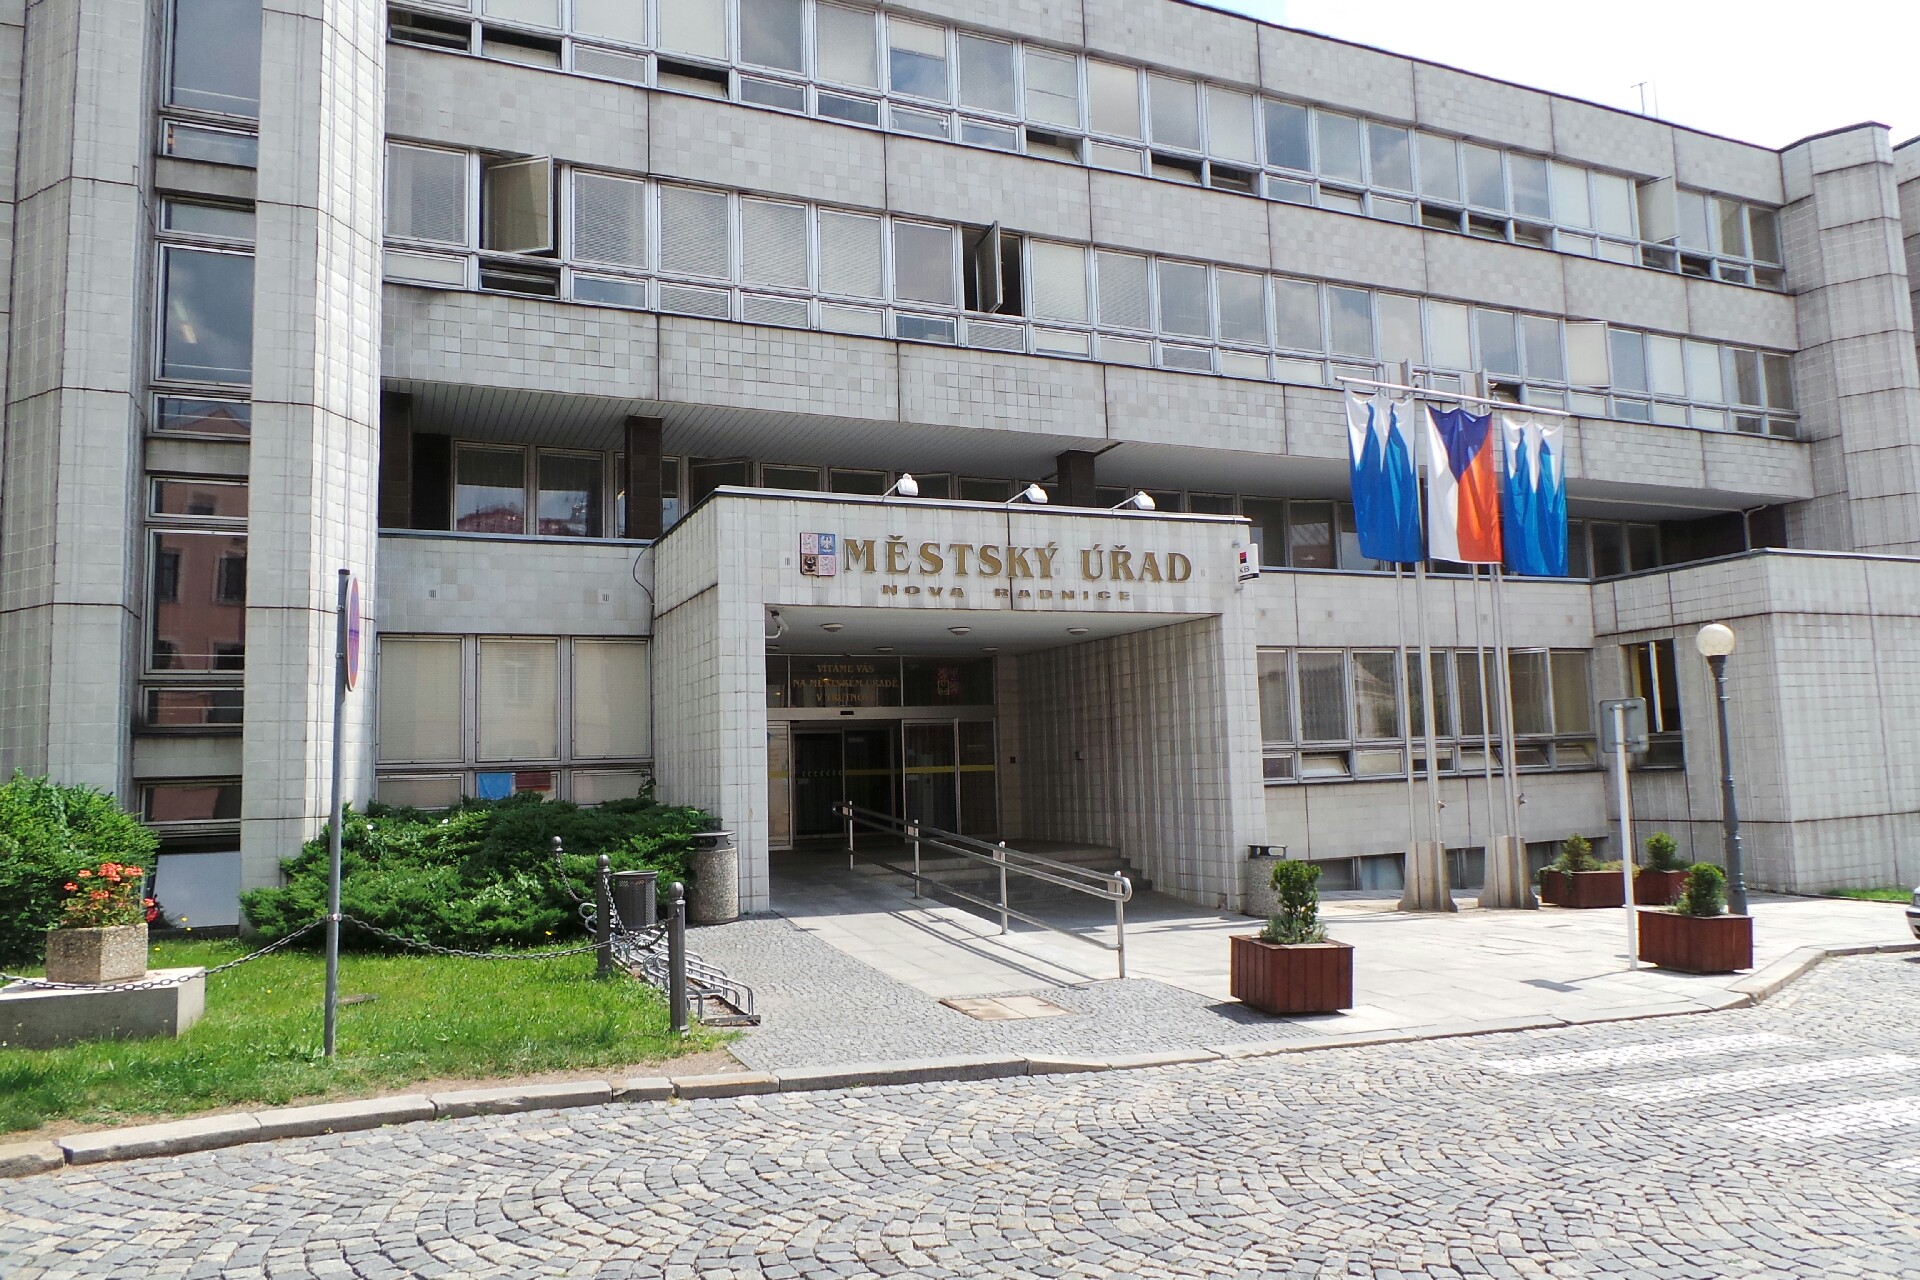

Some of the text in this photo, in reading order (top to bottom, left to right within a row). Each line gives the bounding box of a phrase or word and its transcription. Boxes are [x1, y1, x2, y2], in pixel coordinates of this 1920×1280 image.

[843, 535, 1192, 582] MĚSTSKÝ ÚŘAD
[881, 584, 1130, 600] NOVA RADNICE
[857, 663, 874, 672] VÁS
[793, 679, 805, 687] NA
